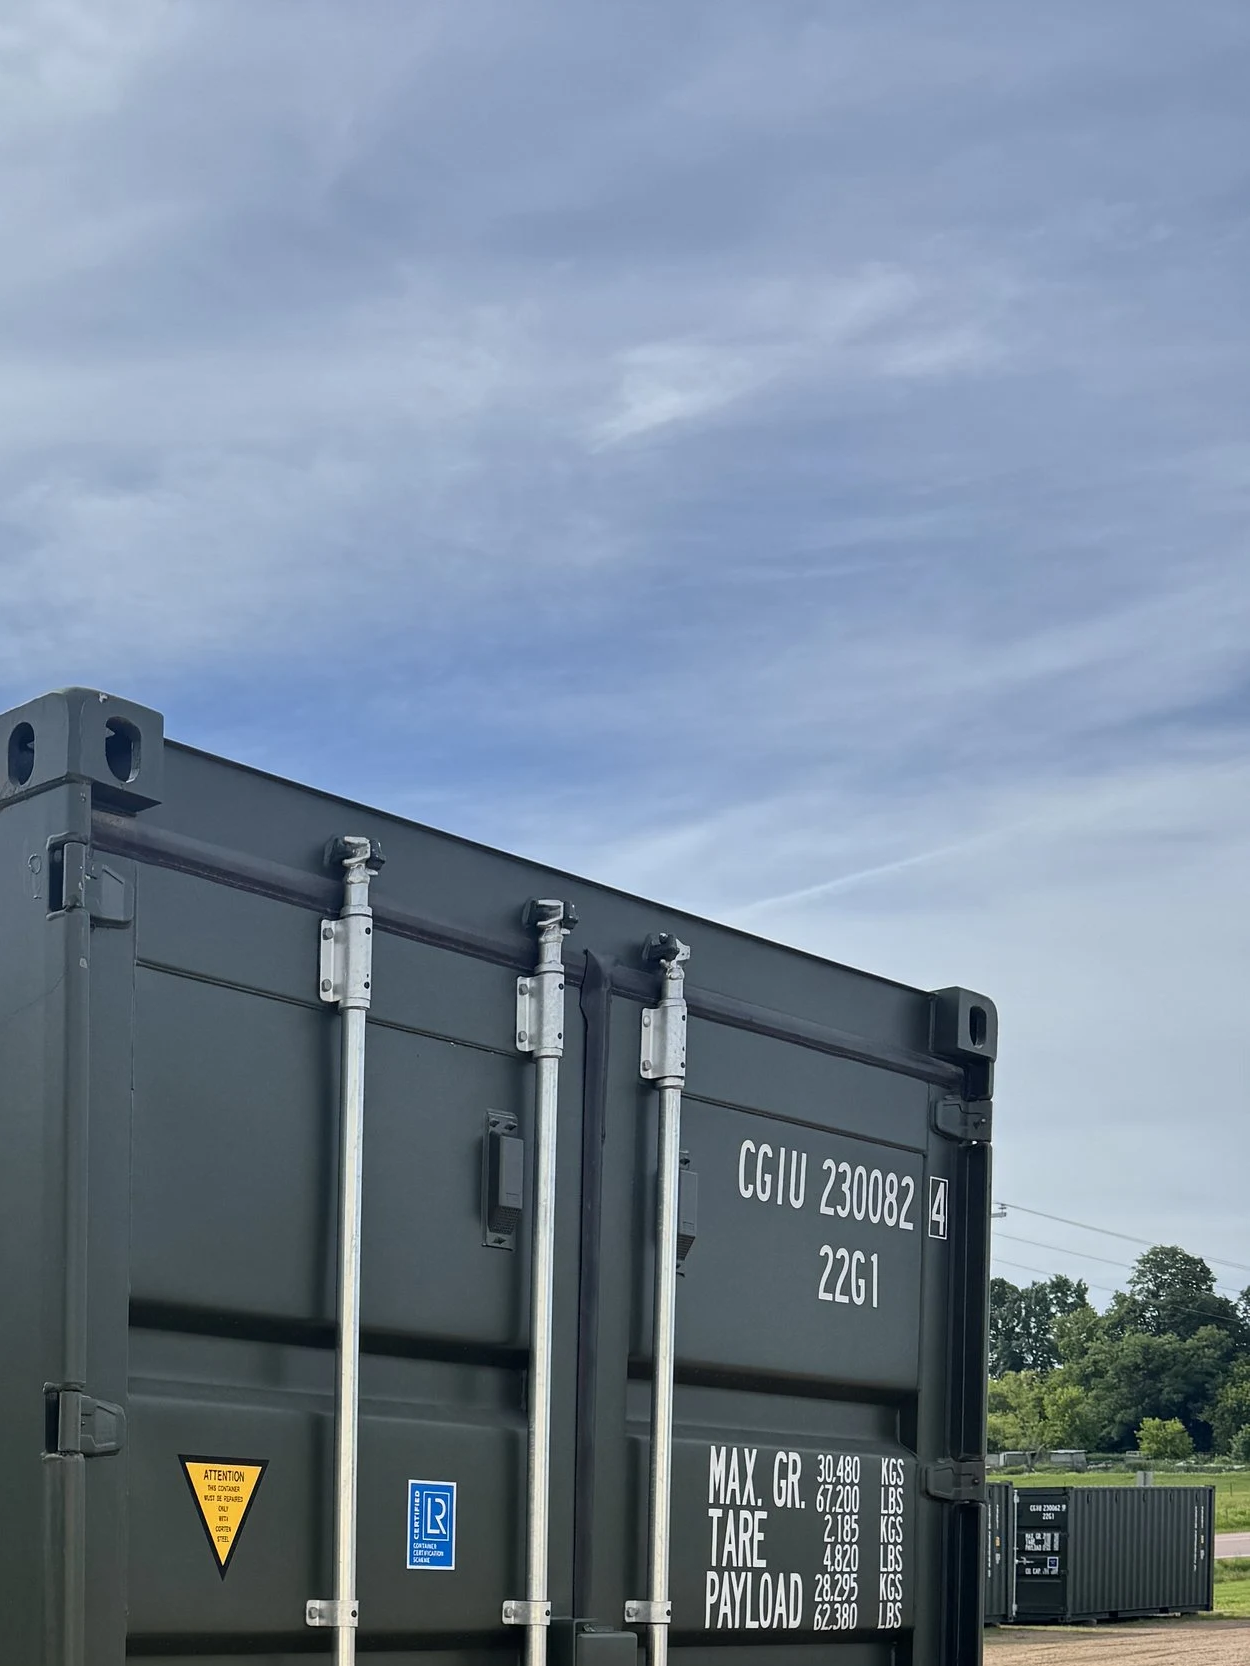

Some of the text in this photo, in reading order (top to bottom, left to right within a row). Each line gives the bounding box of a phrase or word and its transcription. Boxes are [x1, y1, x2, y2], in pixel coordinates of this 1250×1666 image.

[738, 1139, 946, 1236] CGIU 230082 4
[818, 1244, 878, 1309] 22G1
[203, 1469, 245, 1482] ATTENTION
[218, 1485, 240, 1493] CONTAINER
[708, 1445, 905, 1509] MAX. GR. 30,480 KGS
[427, 1497, 447, 1535] LR
[816, 1485, 904, 1514] 67,200 LBS
[708, 1508, 903, 1568] TARE 2,185 KGS
[823, 1544, 903, 1572] 4,820 LBS
[704, 1571, 903, 1629] PAYLOAD 28,295 KGS
[813, 1602, 903, 1631] 62,380 LBS
